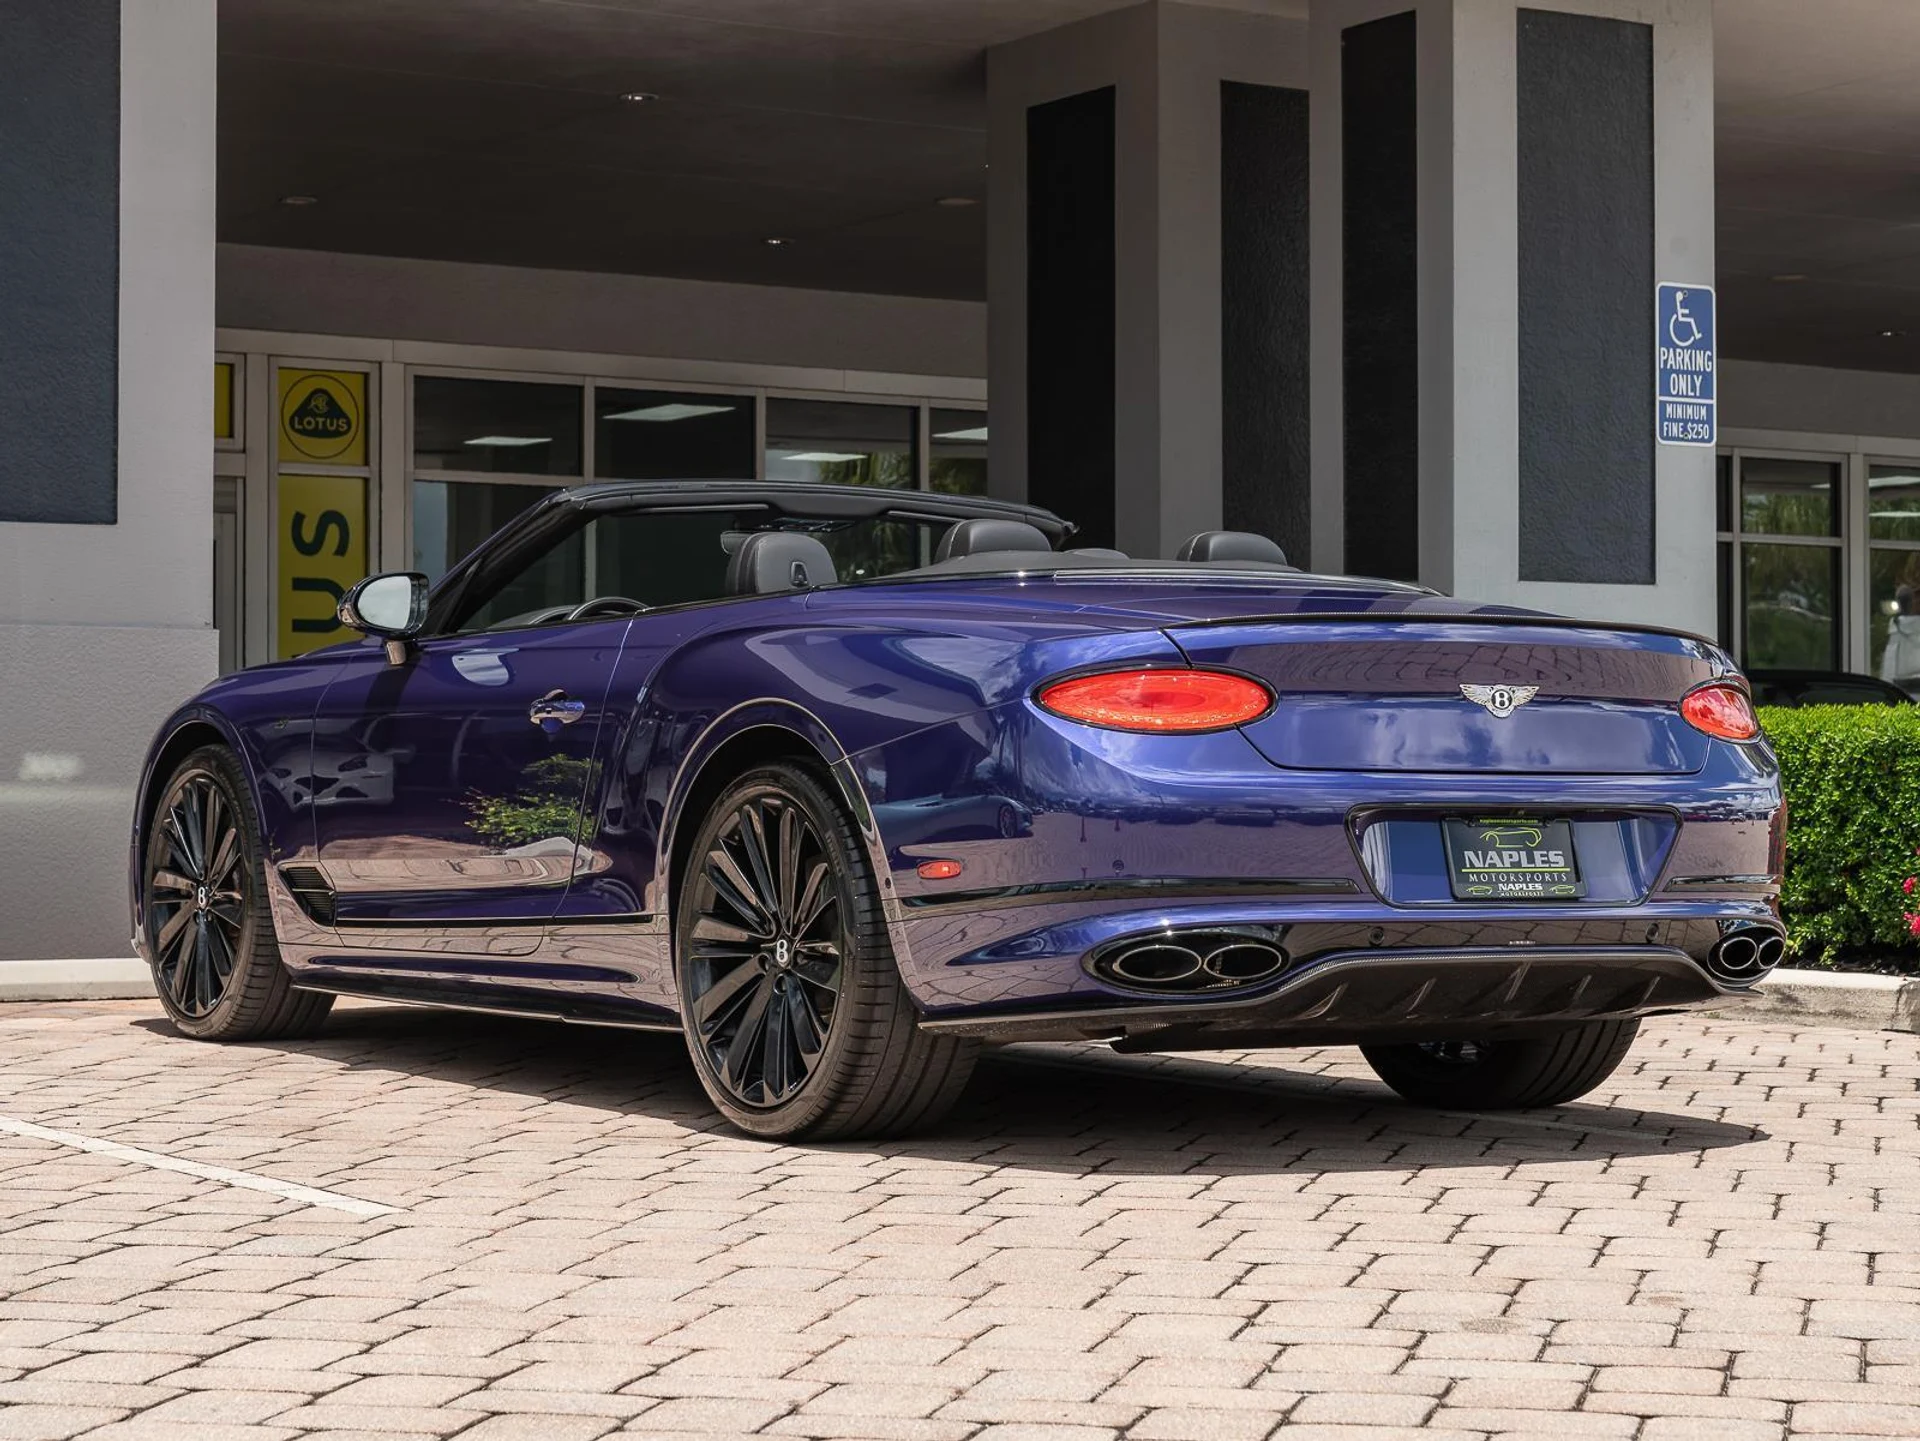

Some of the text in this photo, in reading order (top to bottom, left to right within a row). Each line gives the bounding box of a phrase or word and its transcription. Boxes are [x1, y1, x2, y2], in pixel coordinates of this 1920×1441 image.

[1660, 348, 1712, 372] PARKING
[1670, 374, 1702, 396] ONLY
[1666, 403, 1706, 420] MINIMUM
[294, 416, 349, 432] LOTUS
[1664, 422, 1709, 439] FINE $250
[292, 510, 350, 657] US
[1494, 691, 1510, 708] B
[1464, 850, 1565, 868] NAPLES
[1469, 872, 1567, 882] MOTORSPORTS
[1498, 883, 1543, 891] NAPLES
